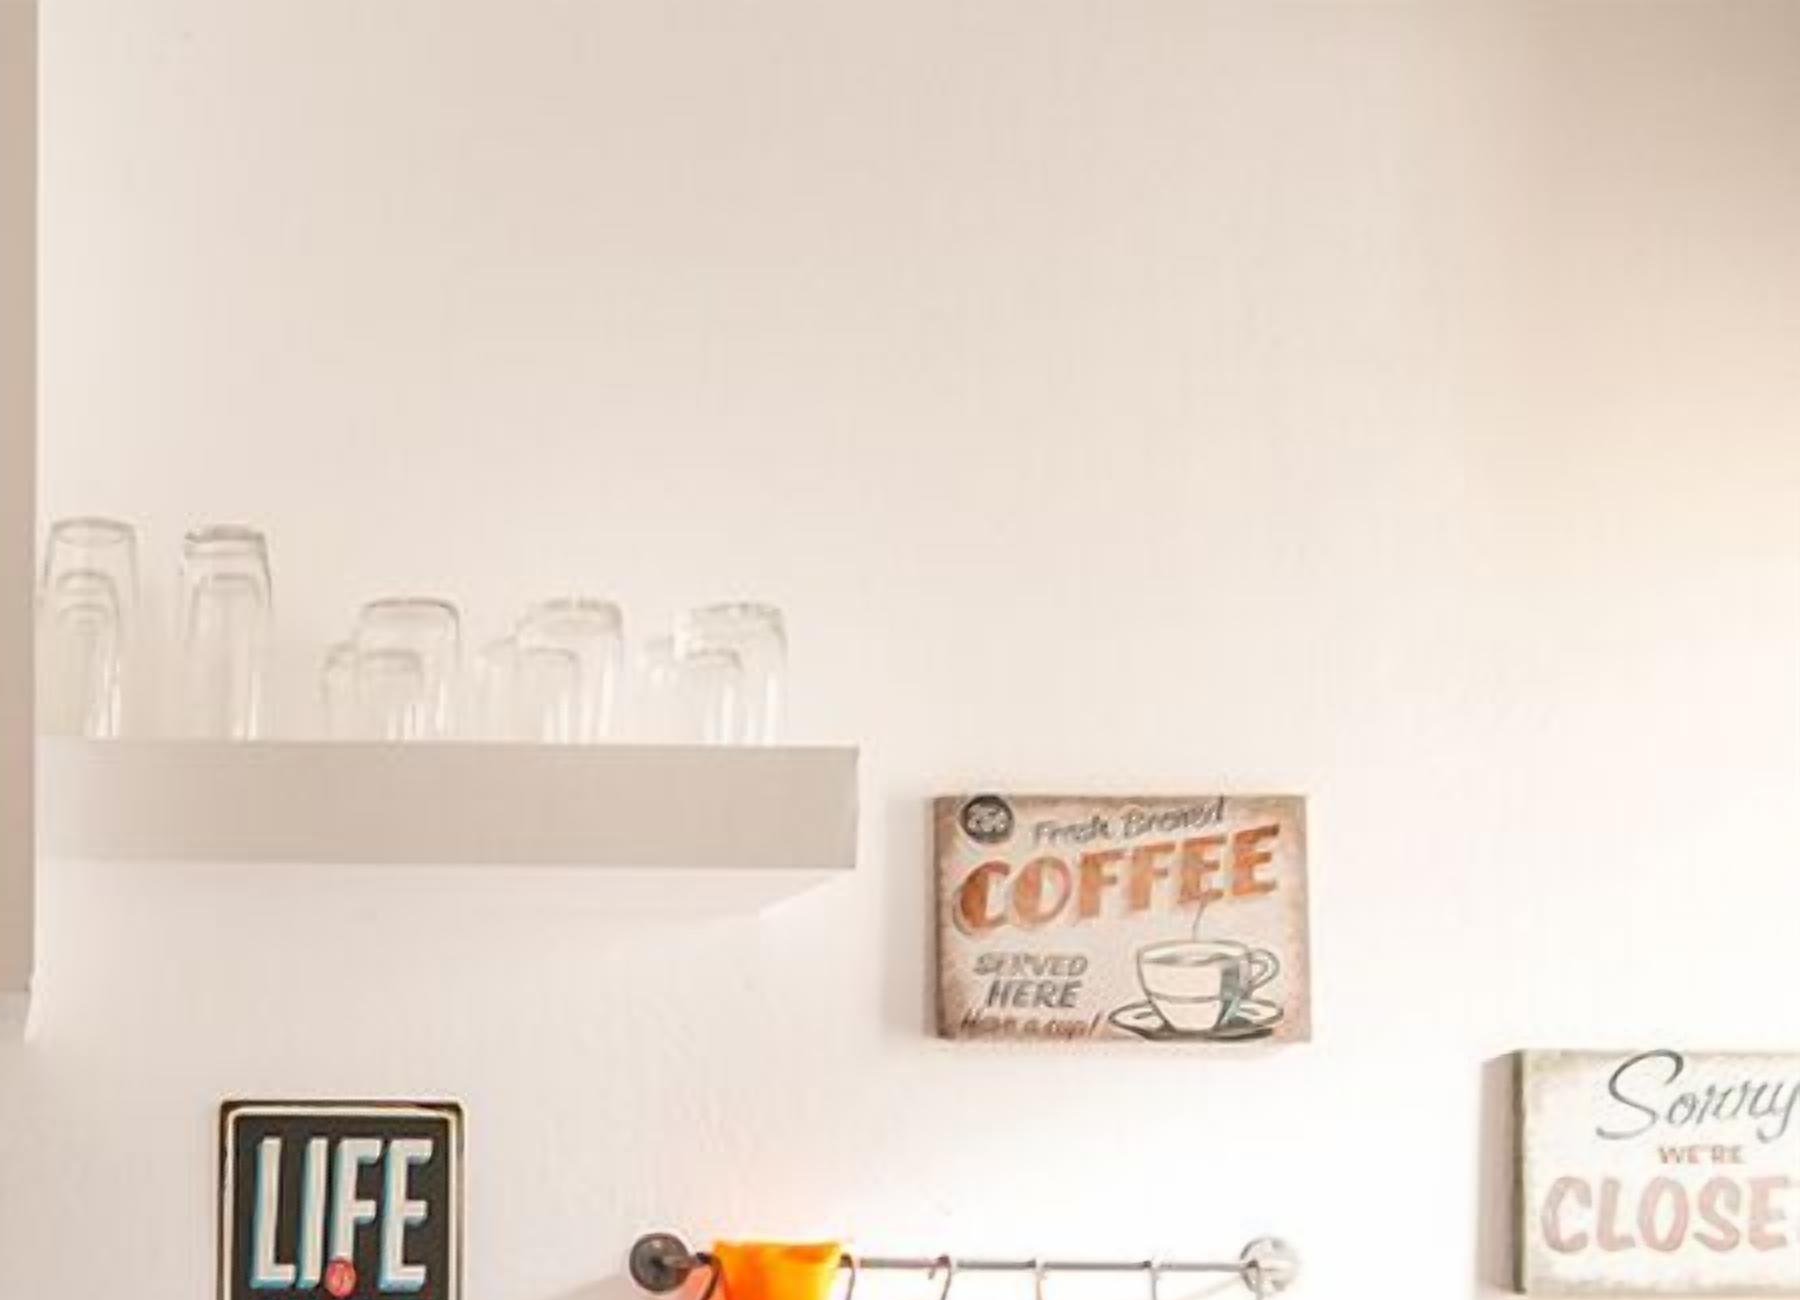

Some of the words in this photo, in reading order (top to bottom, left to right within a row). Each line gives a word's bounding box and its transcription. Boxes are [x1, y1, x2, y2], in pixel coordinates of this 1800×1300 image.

[953, 823, 1281, 935] COFFEE
[987, 979, 1084, 1009] HERE
[1595, 1048, 1800, 1145] Sorry
[250, 1136, 434, 1291] LIFE
[1540, 1175, 1800, 1255] CLOSE
